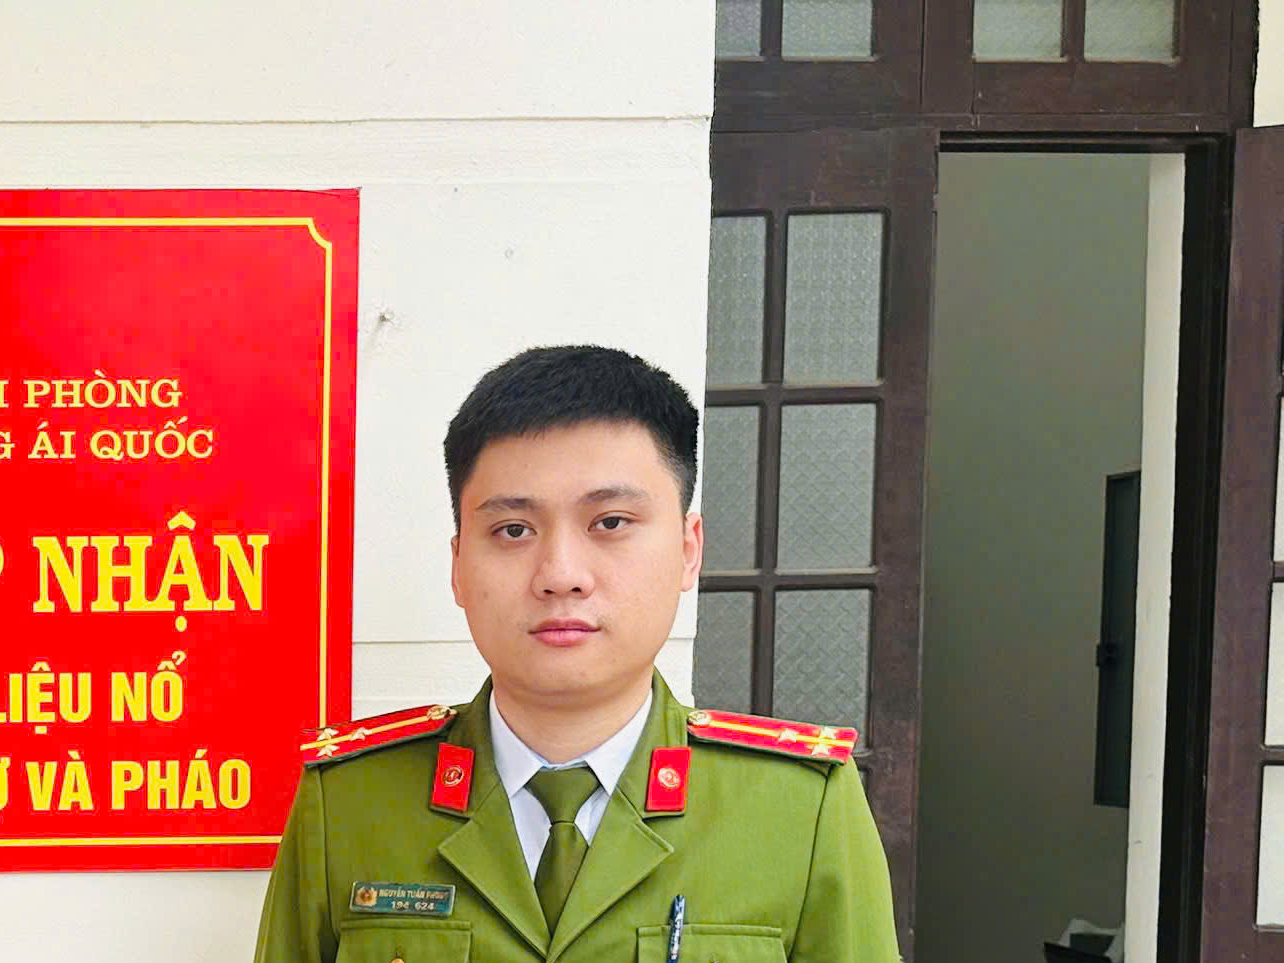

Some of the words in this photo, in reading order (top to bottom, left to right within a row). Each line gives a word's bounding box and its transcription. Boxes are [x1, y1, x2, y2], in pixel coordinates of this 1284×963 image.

[23, 369, 183, 409] PHÒNG
[27, 421, 77, 460] ÁI
[89, 415, 214, 461] QUỐC
[32, 511, 270, 633] NHẬN
[111, 650, 187, 723] NỔ
[25, 750, 94, 812] VÀ
[111, 749, 251, 812] PHÁO
